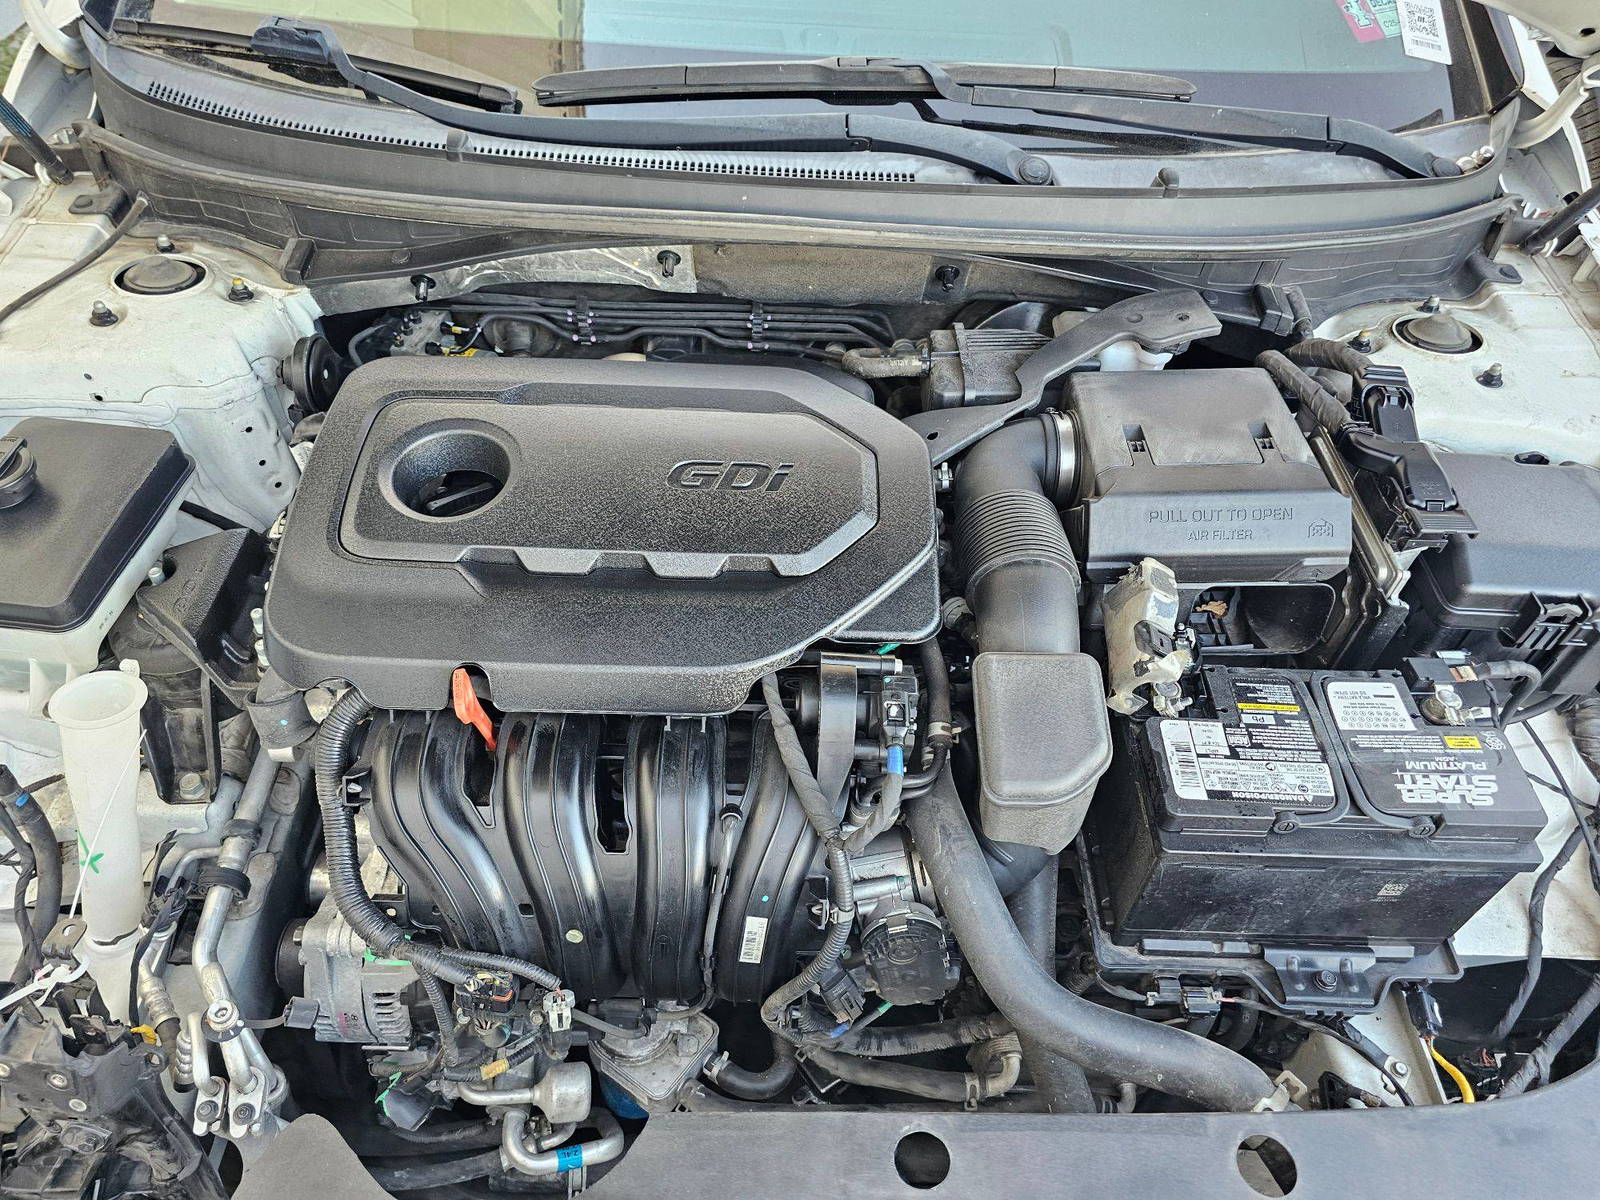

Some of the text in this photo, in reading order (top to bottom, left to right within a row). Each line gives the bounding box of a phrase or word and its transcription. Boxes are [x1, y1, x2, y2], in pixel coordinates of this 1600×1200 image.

[666, 460, 794, 492] GDi
[1149, 507, 1293, 523] PULL OUT TO OPEN
[1187, 529, 1253, 541] AIR FILTER
[1404, 760, 1488, 770] PLATINUM
[1394, 774, 1498, 793] START
[1401, 789, 1494, 806] SUPER
